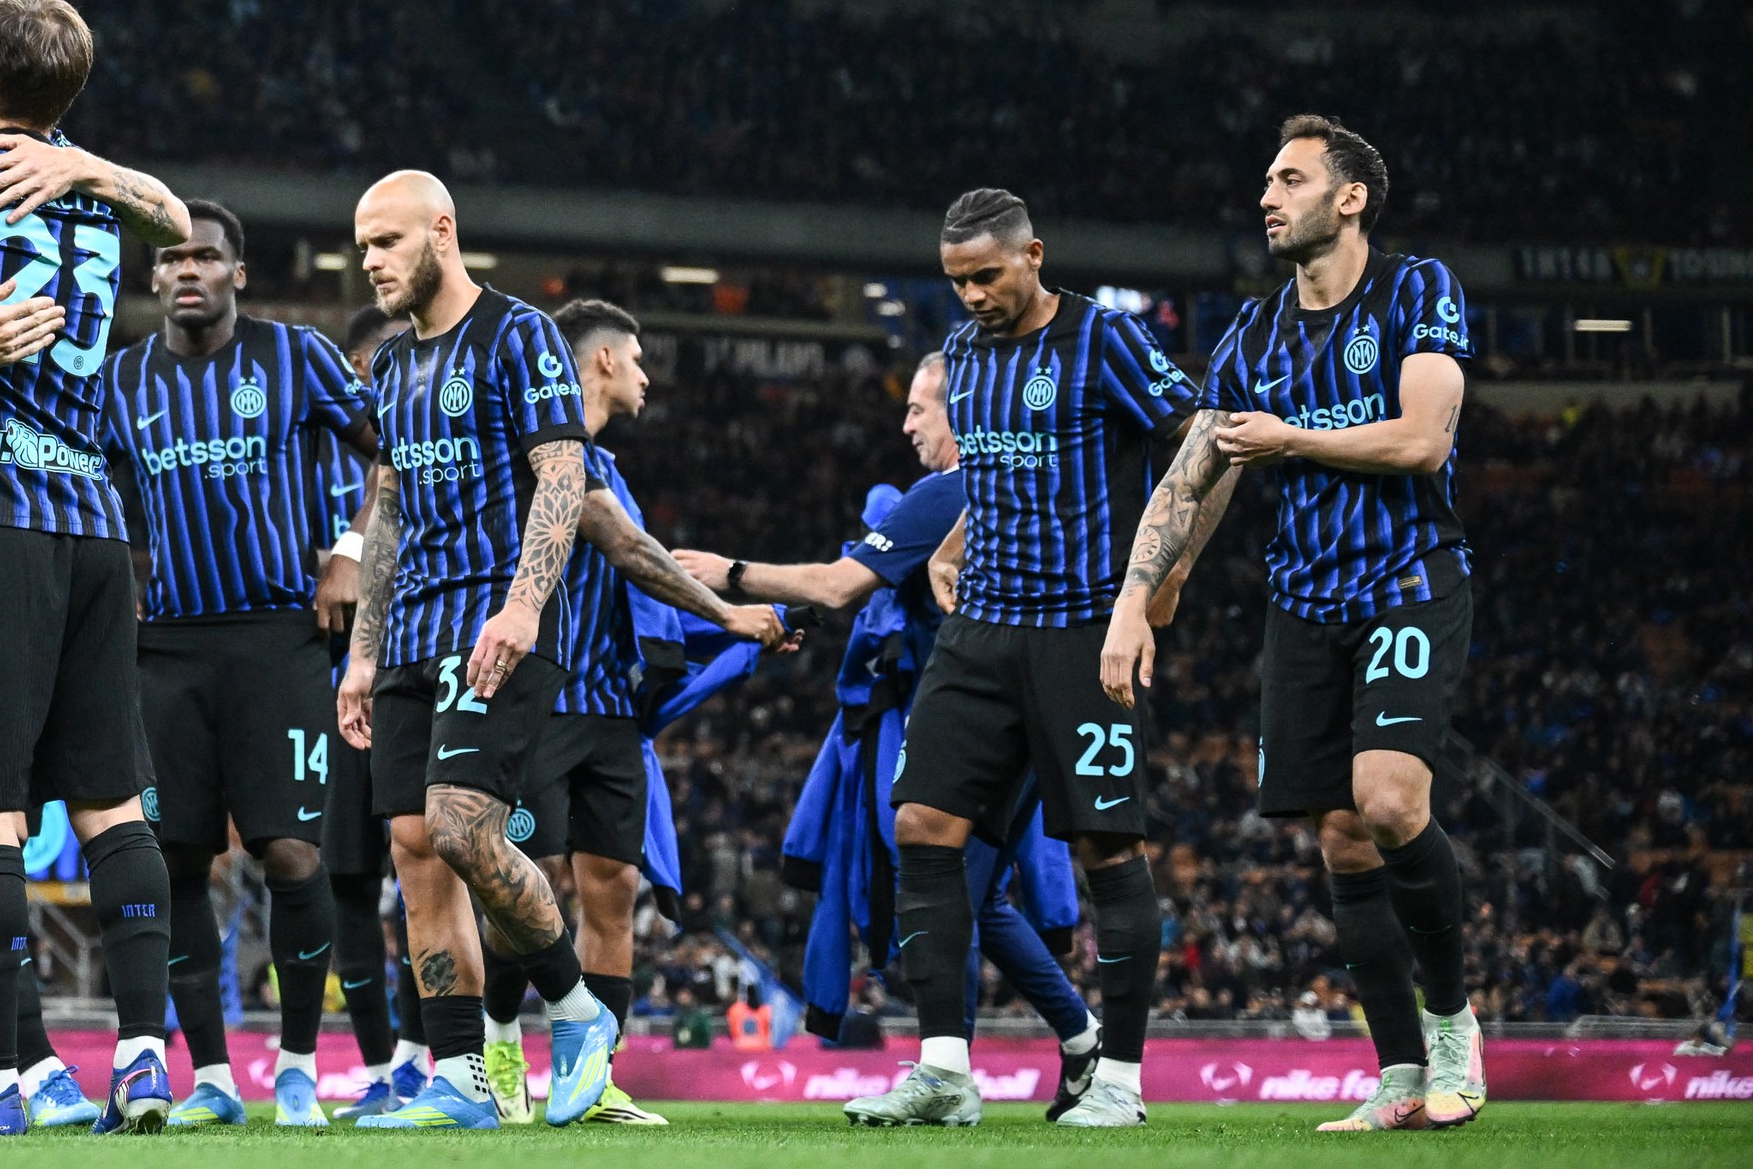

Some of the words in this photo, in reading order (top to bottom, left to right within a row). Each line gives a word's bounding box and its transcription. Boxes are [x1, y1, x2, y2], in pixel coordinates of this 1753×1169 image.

[523, 380, 582, 405] Gate.io
[1283, 392, 1385, 431] etsson
[141, 435, 266, 476] betsson
[204, 457, 267, 481] .sport
[390, 436, 479, 472] etsson
[418, 460, 481, 488] .sport
[1365, 625, 1431, 682] 20
[435, 655, 488, 715] 32
[287, 728, 329, 786] 14
[1074, 721, 1135, 778] 25
[121, 903, 157, 919] INTER
